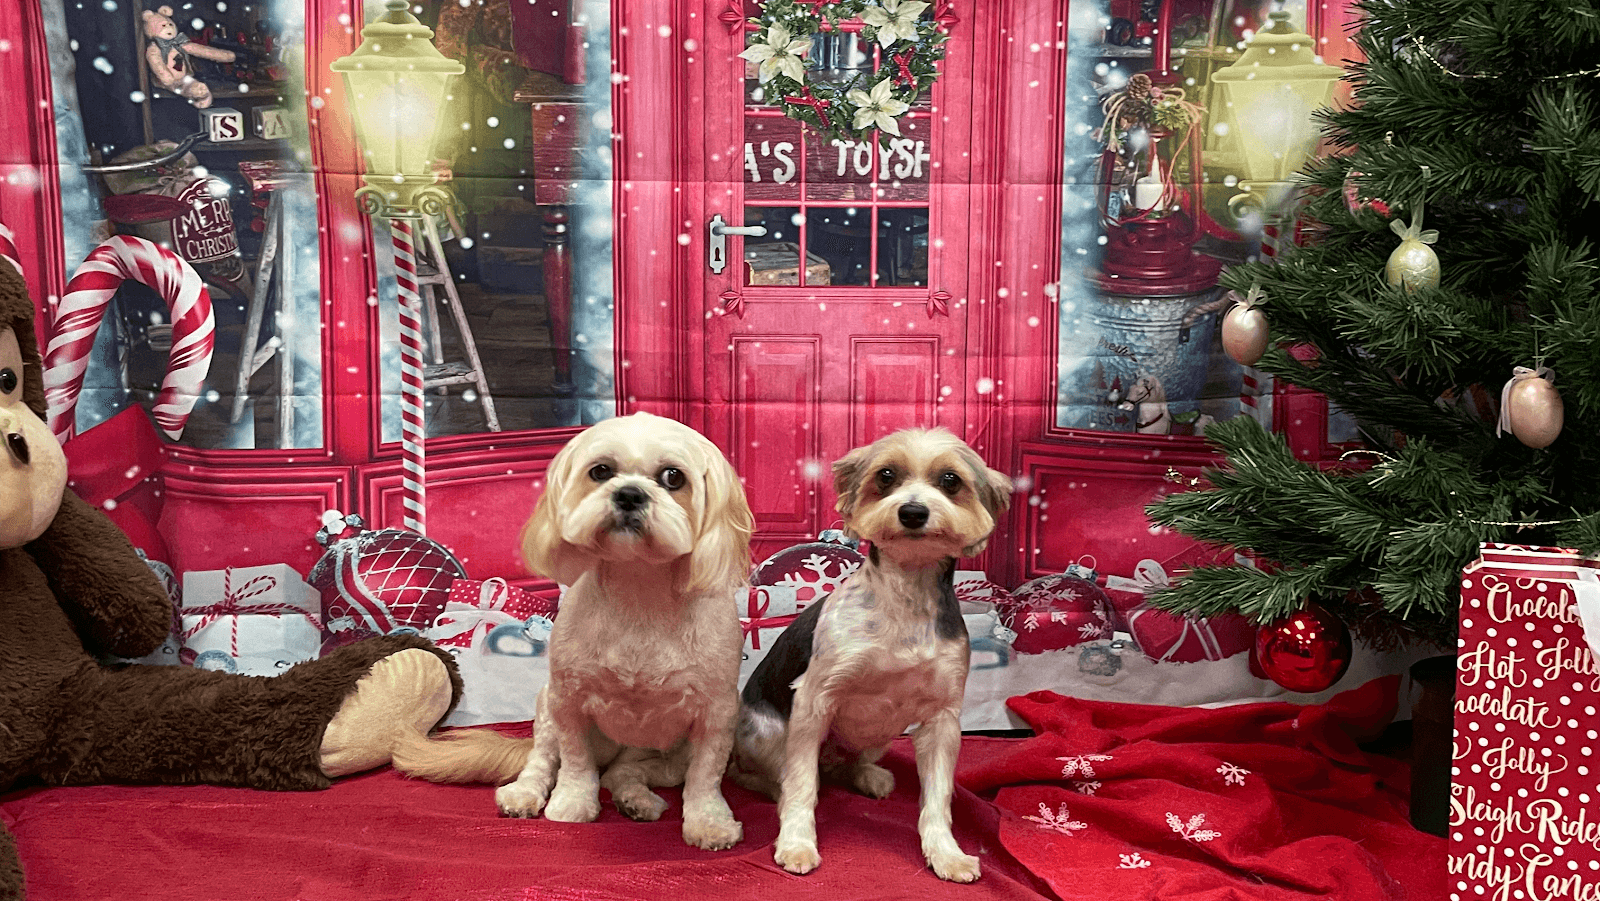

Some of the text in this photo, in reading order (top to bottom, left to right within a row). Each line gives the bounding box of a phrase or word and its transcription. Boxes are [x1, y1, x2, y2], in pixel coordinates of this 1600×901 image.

[219, 115, 239, 139] S
[1456, 640, 1527, 688] Hot
[1482, 737, 1568, 793] Jolly
